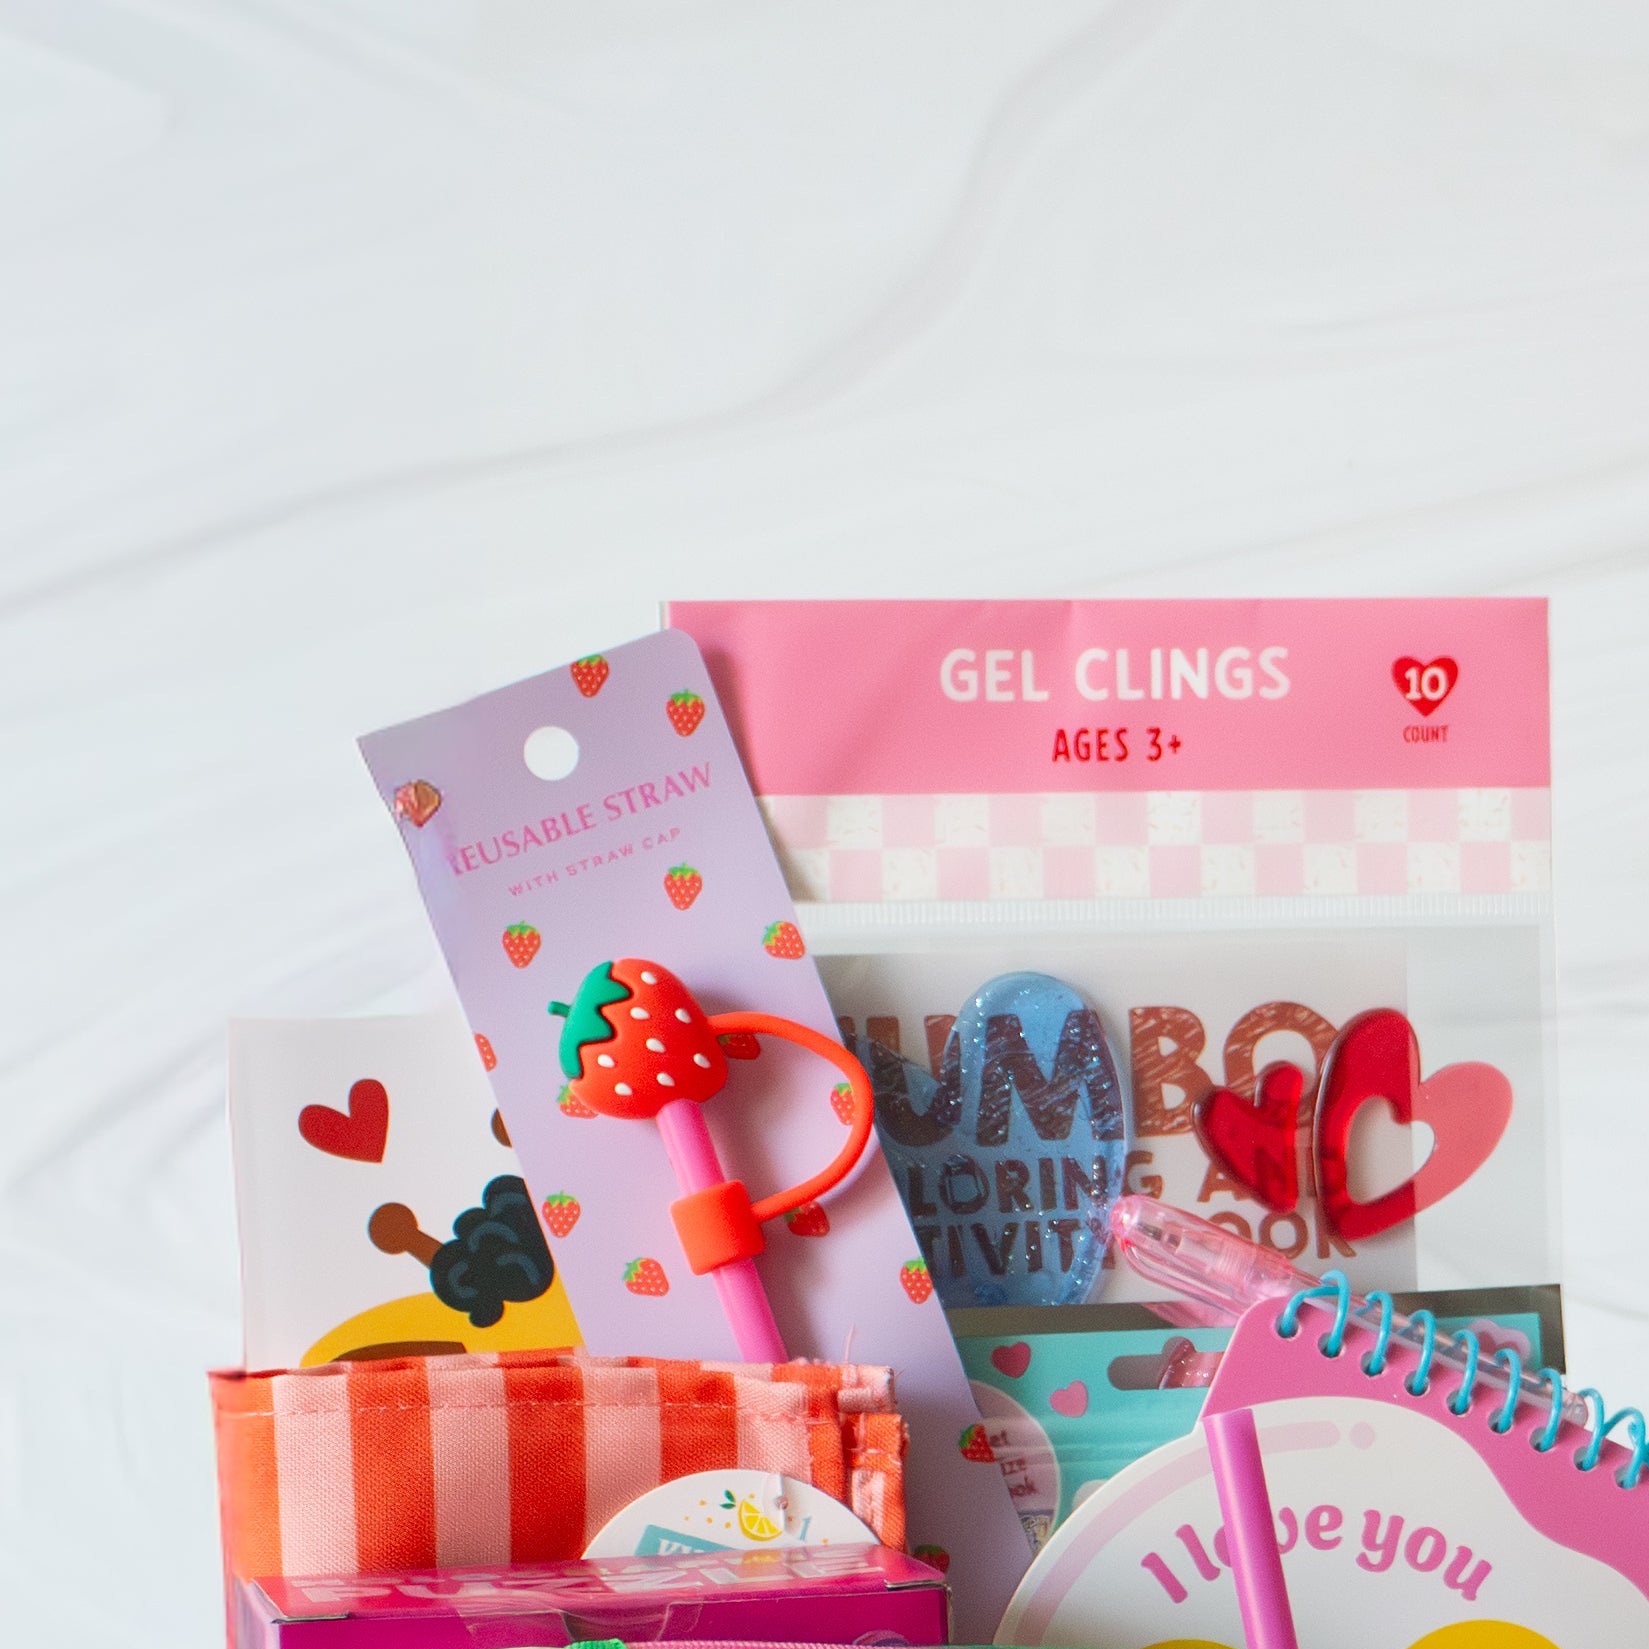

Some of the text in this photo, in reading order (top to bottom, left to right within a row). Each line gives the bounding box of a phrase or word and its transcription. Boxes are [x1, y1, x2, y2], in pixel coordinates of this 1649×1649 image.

[940, 645, 1291, 702] GEL CLINGS
[1404, 666, 1446, 702] 10
[1052, 728, 1182, 763] AGES 3+
[1402, 725, 1450, 745] COUNT
[603, 761, 712, 822] STRAW
[507, 827, 682, 897] WITH STRAW CAP
[840, 1001, 1338, 1147] UMBO
[907, 1151, 1163, 1217] LORING
[1141, 1551, 1189, 1604] I
[1355, 1508, 1493, 1602] you
